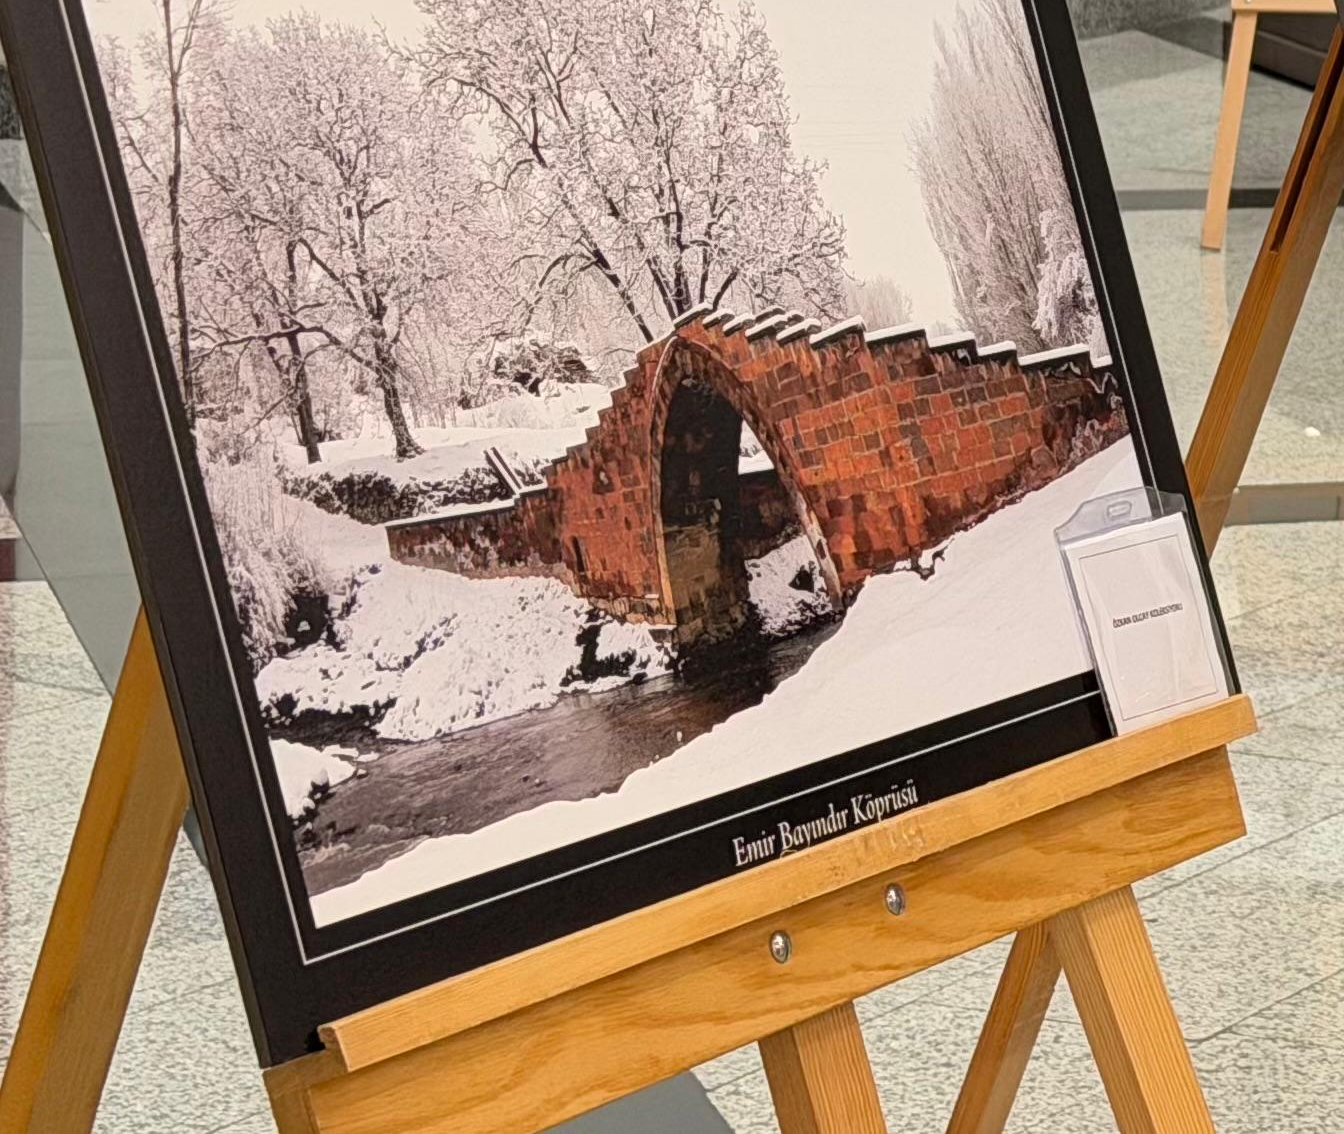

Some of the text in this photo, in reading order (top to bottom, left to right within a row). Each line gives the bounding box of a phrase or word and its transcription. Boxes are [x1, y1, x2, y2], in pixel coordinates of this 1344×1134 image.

[732, 779, 919, 866] Emir Bayındır Köprüsü
